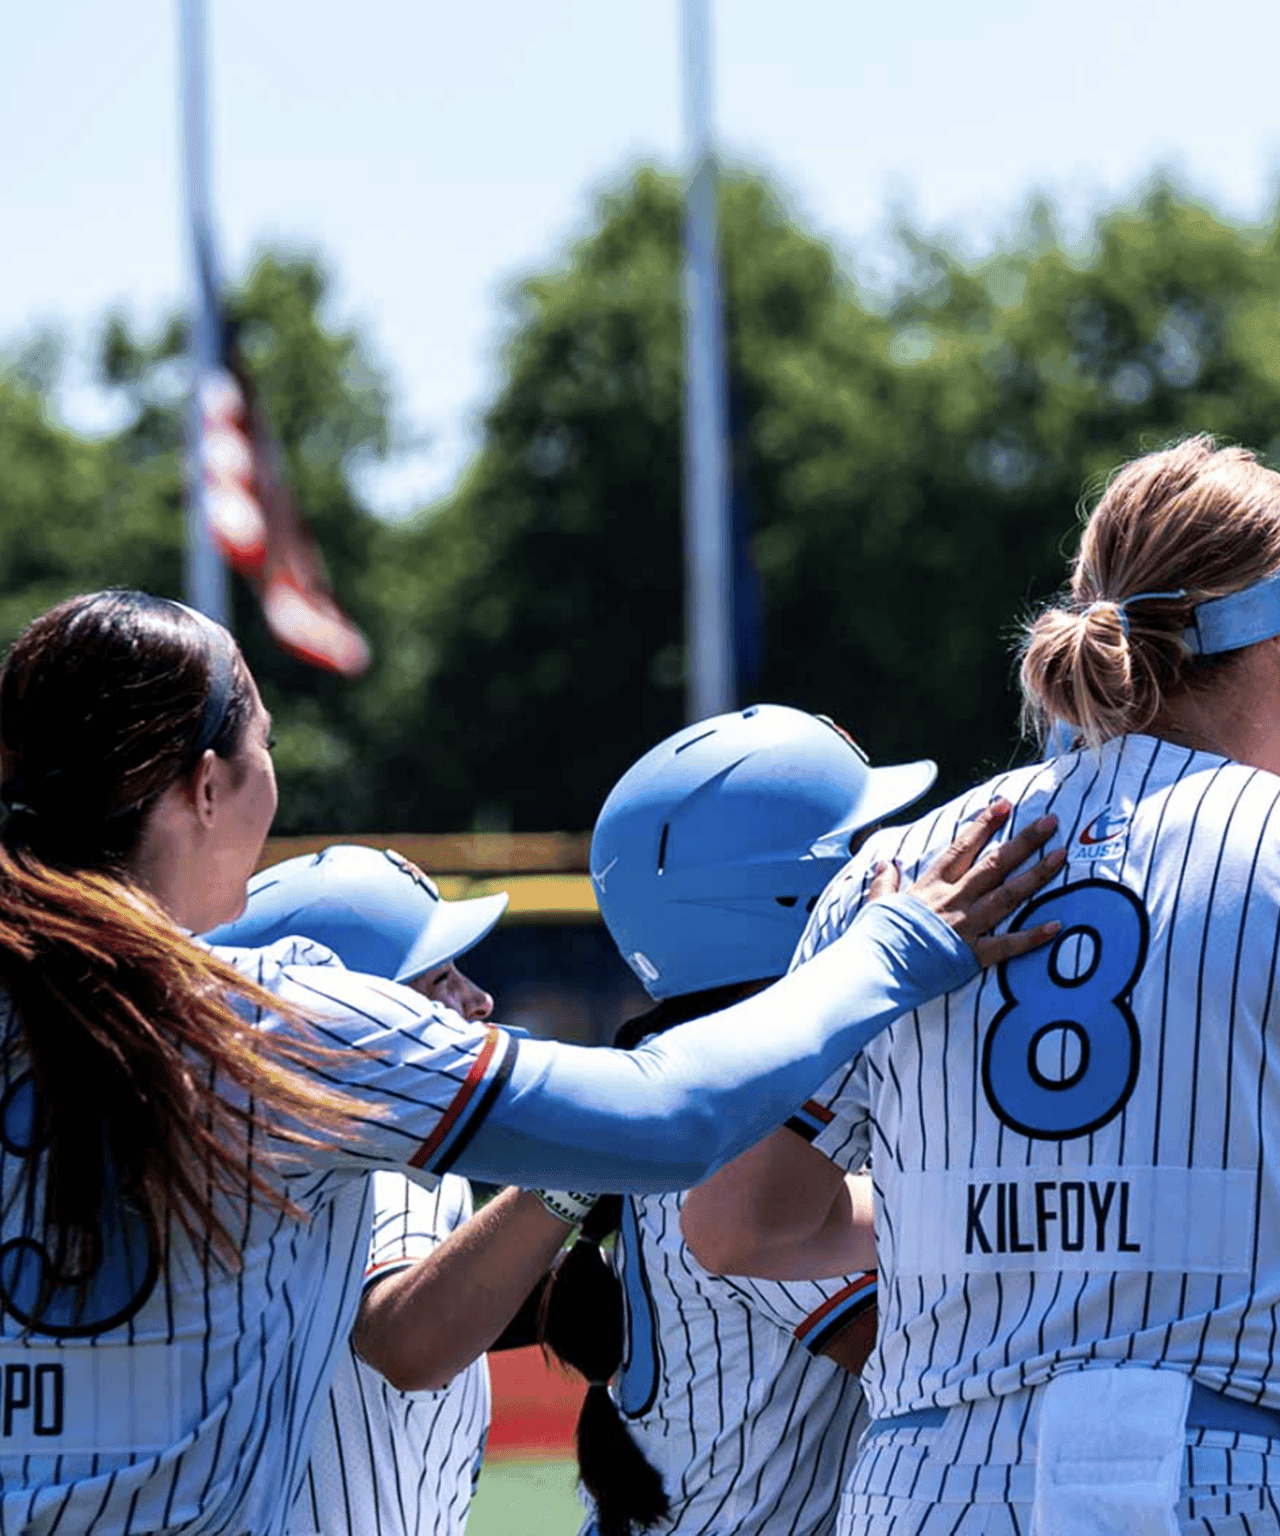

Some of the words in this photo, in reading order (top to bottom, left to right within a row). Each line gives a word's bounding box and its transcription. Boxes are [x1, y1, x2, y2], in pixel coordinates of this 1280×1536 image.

[1074, 844, 1117, 859] AUS
[982, 878, 1149, 1141] 8
[965, 1181, 1141, 1254] KILFOYL
[2, 1363, 63, 1437] PO
